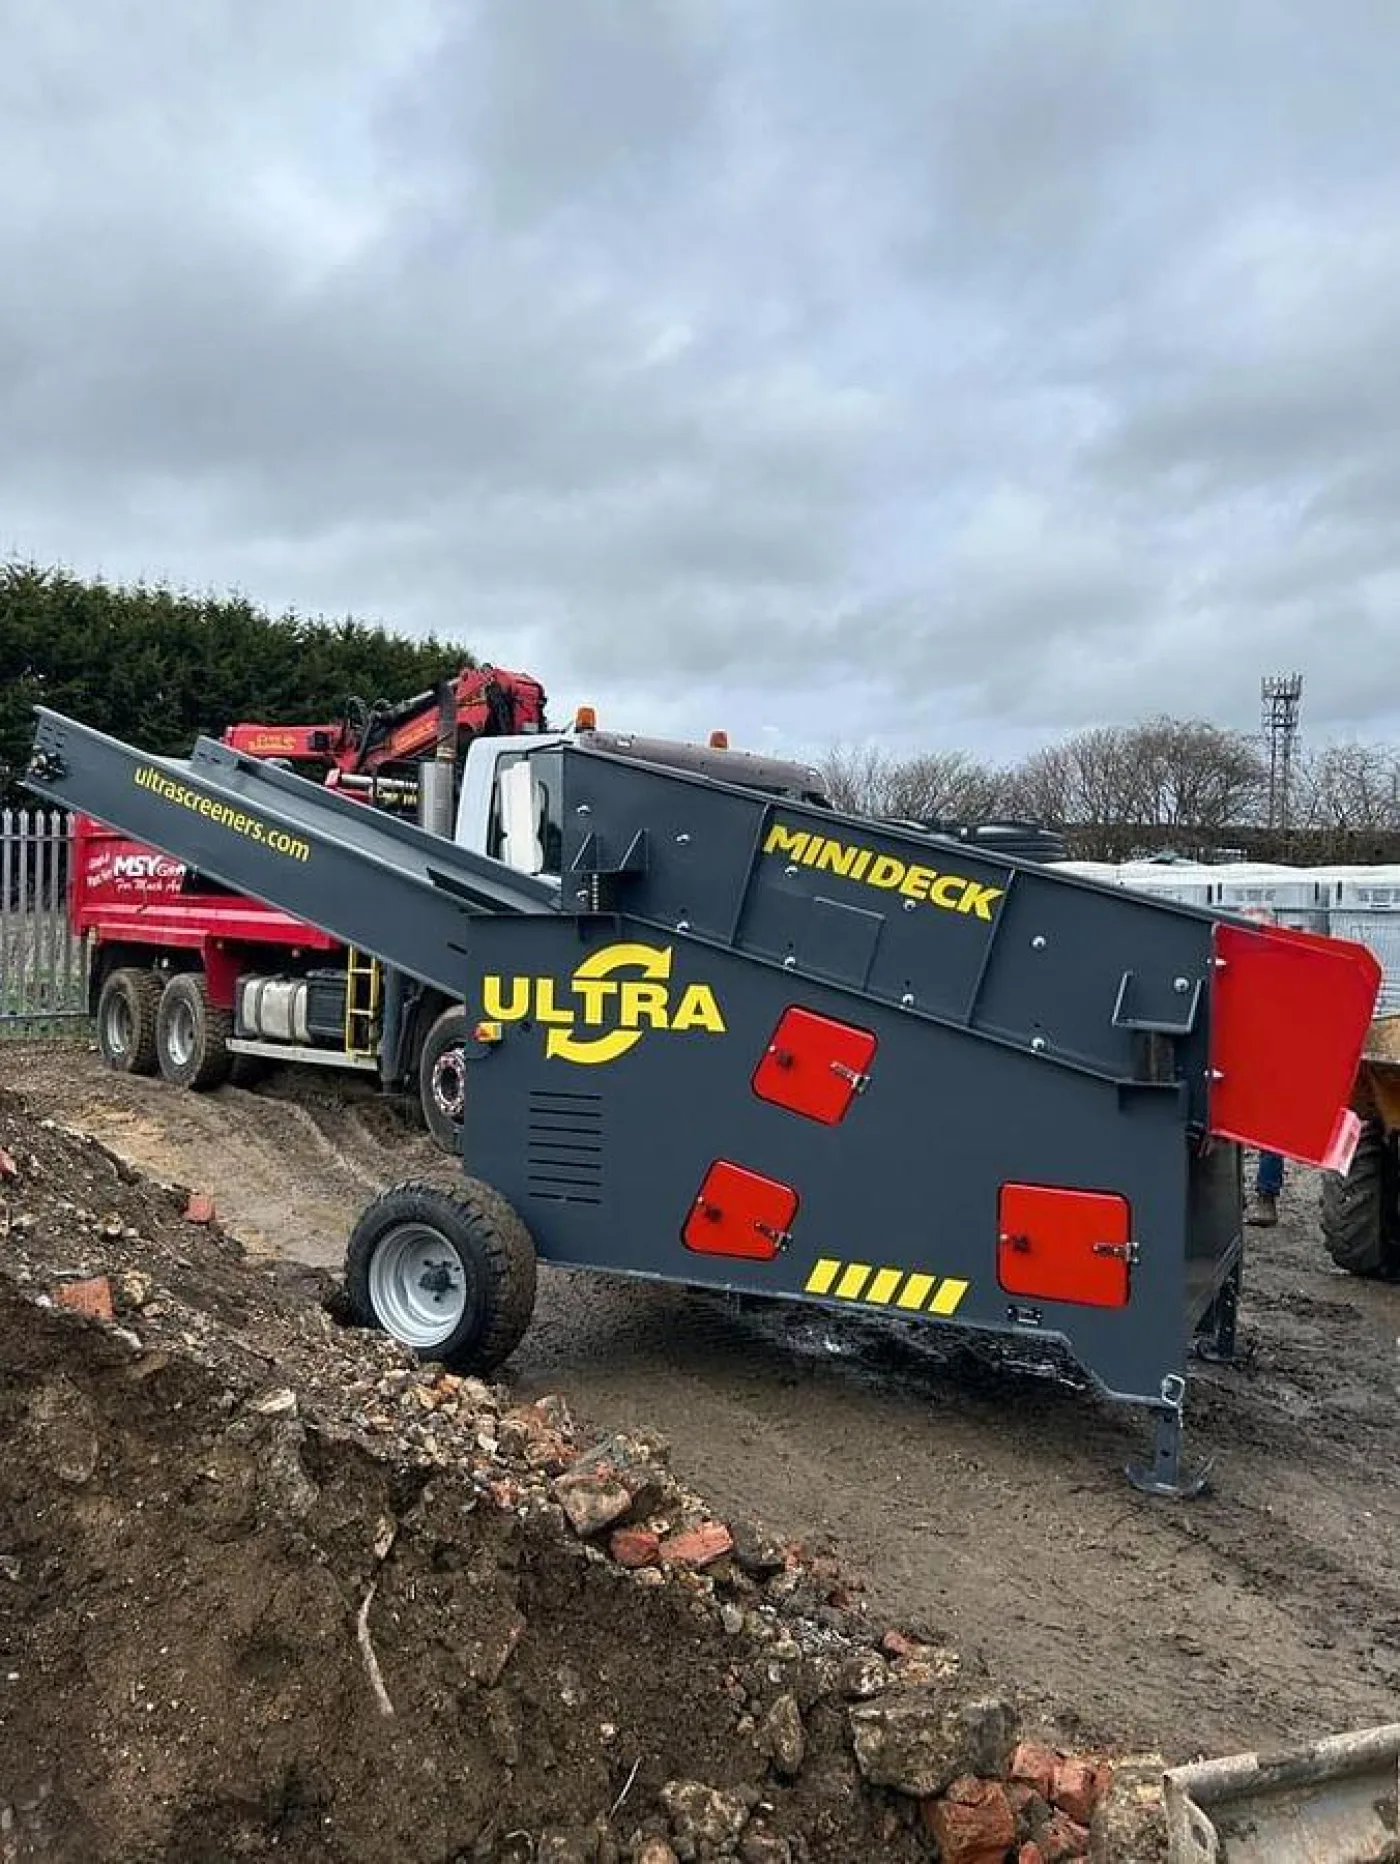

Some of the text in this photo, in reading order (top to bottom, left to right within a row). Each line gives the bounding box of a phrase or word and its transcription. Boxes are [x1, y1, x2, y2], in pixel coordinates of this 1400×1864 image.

[134, 766, 310, 862] ultrascreeners.com
[762, 824, 1005, 921] MINIDECK
[483, 976, 726, 1033] ULTRA
